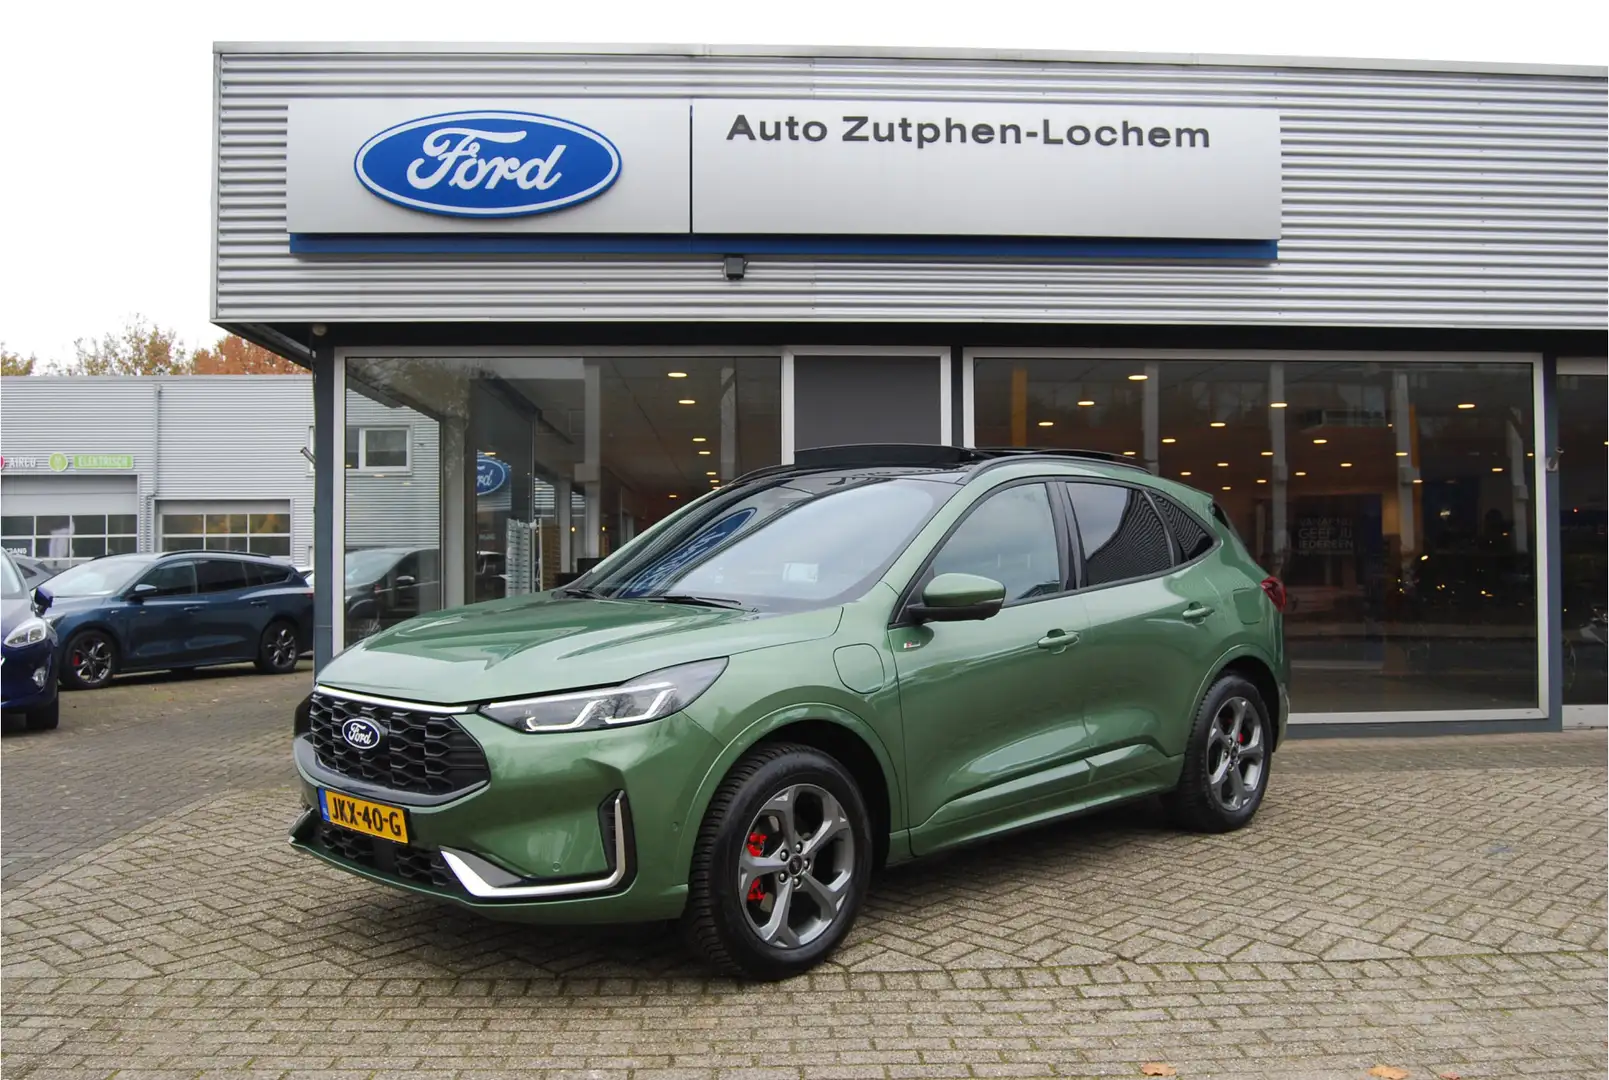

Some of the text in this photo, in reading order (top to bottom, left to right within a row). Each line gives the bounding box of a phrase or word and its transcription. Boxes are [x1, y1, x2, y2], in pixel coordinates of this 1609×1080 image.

[726, 114, 1211, 149] Auto Zutphen-Lochem
[406, 127, 567, 190] Ford
[348, 723, 372, 745] Ford
[332, 797, 402, 836] JKX-40-G
